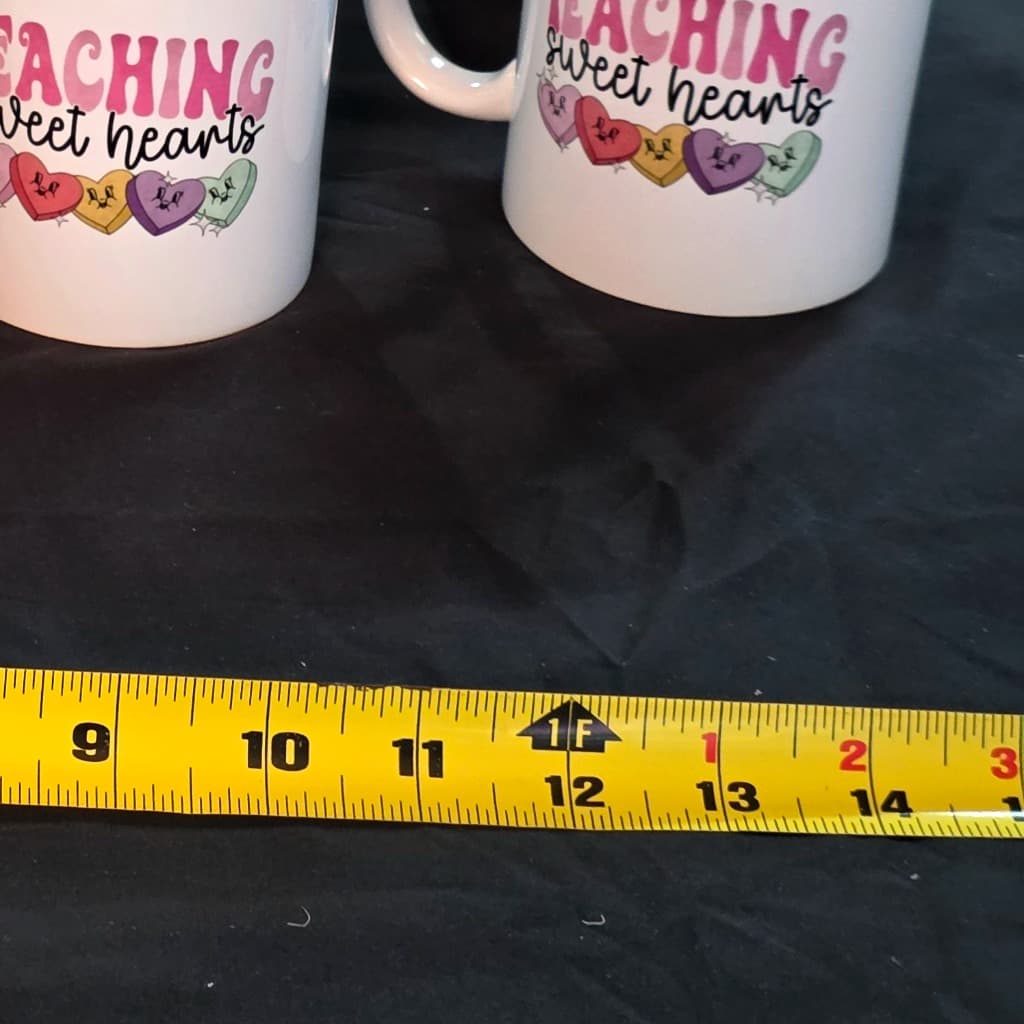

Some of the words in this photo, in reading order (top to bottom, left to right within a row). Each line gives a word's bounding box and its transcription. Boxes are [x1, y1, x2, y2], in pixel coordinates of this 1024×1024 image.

[545, 26, 652, 106] sweet
[667, 65, 833, 126] hearts
[107, 103, 265, 170] hearts
[71, 722, 111, 763] 9
[241, 730, 310, 772] 10
[391, 738, 444, 778] 11
[700, 732, 718, 764] 1
[839, 739, 868, 772] 2
[990, 747, 1018, 780] 3
[544, 775, 605, 808] 12
[695, 780, 760, 814] 13
[850, 788, 913, 818] 14
